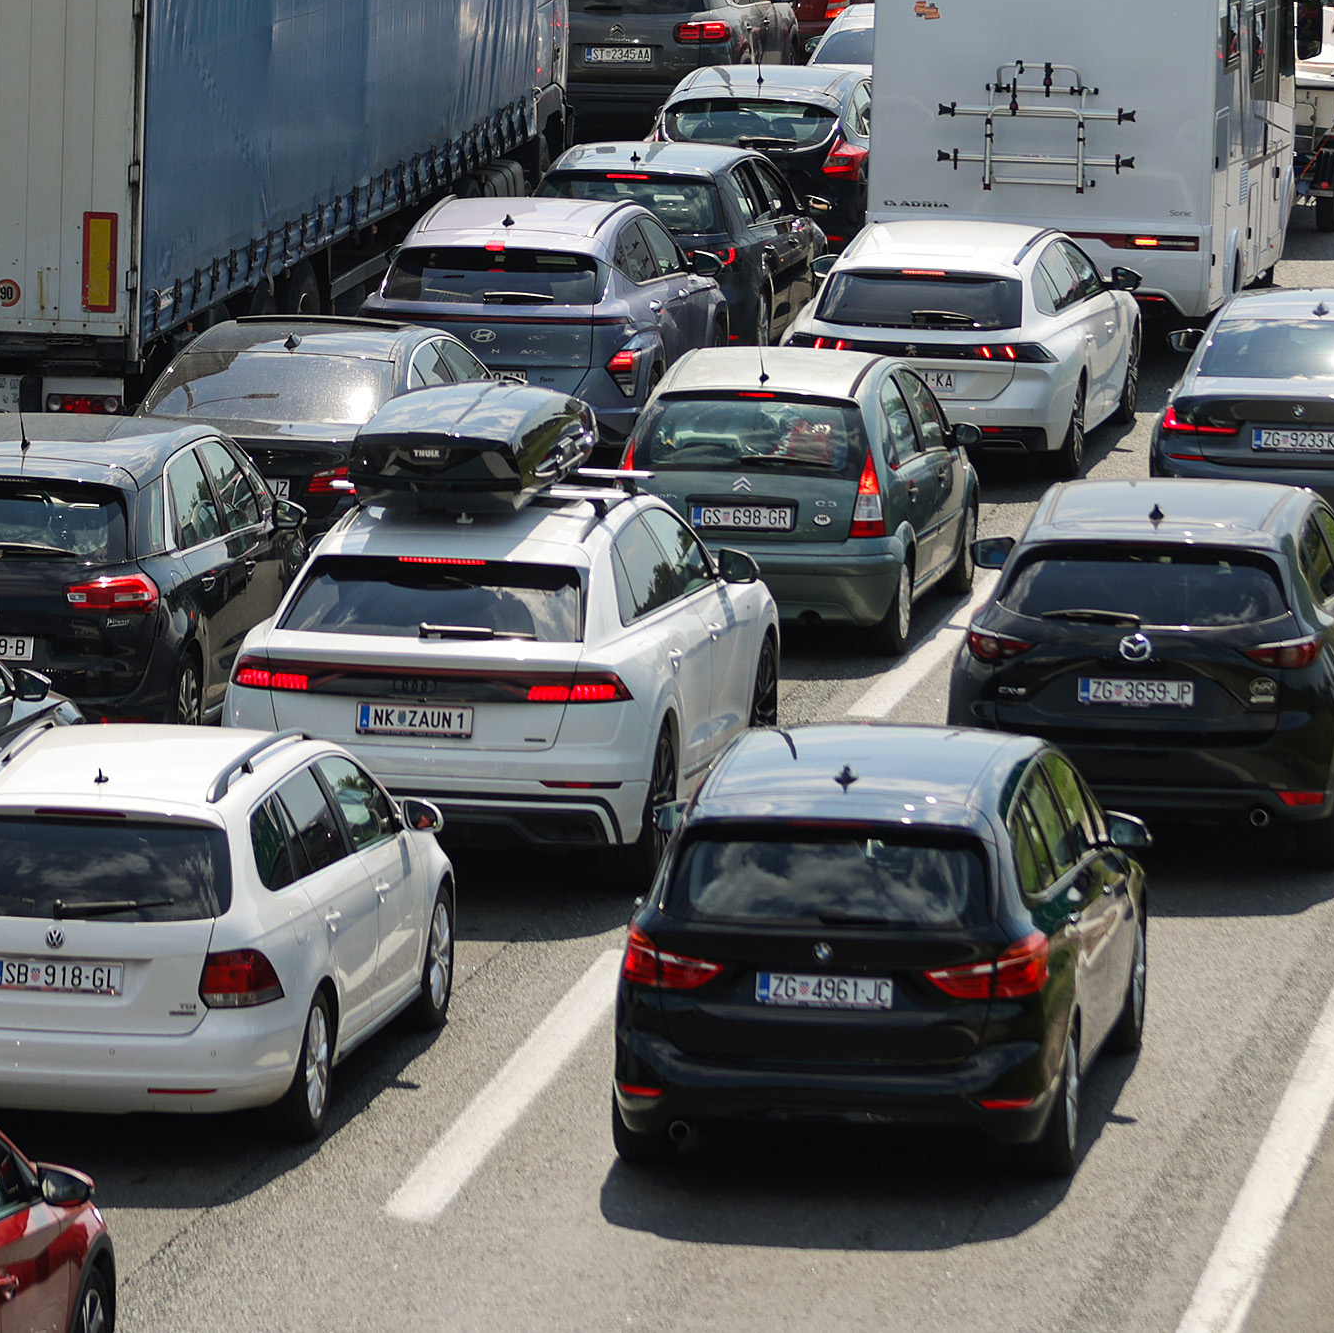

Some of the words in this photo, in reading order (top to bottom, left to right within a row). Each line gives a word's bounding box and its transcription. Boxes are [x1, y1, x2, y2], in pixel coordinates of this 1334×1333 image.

[592, 49, 605, 60] ST
[900, 199, 949, 208] ADRIA
[1169, 209, 1193, 217] Sonic
[0, 286, 14, 300] 90
[1262, 431, 1281, 447] ZG
[413, 449, 440, 459] THULE
[702, 508, 722, 526] GS
[1091, 680, 1113, 700] ZG
[373, 708, 395, 726] NK
[408, 710, 453, 729] ZAUN
[457, 712, 465, 729] 1
[4, 962, 29, 985] SB
[771, 974, 798, 999] ZG
